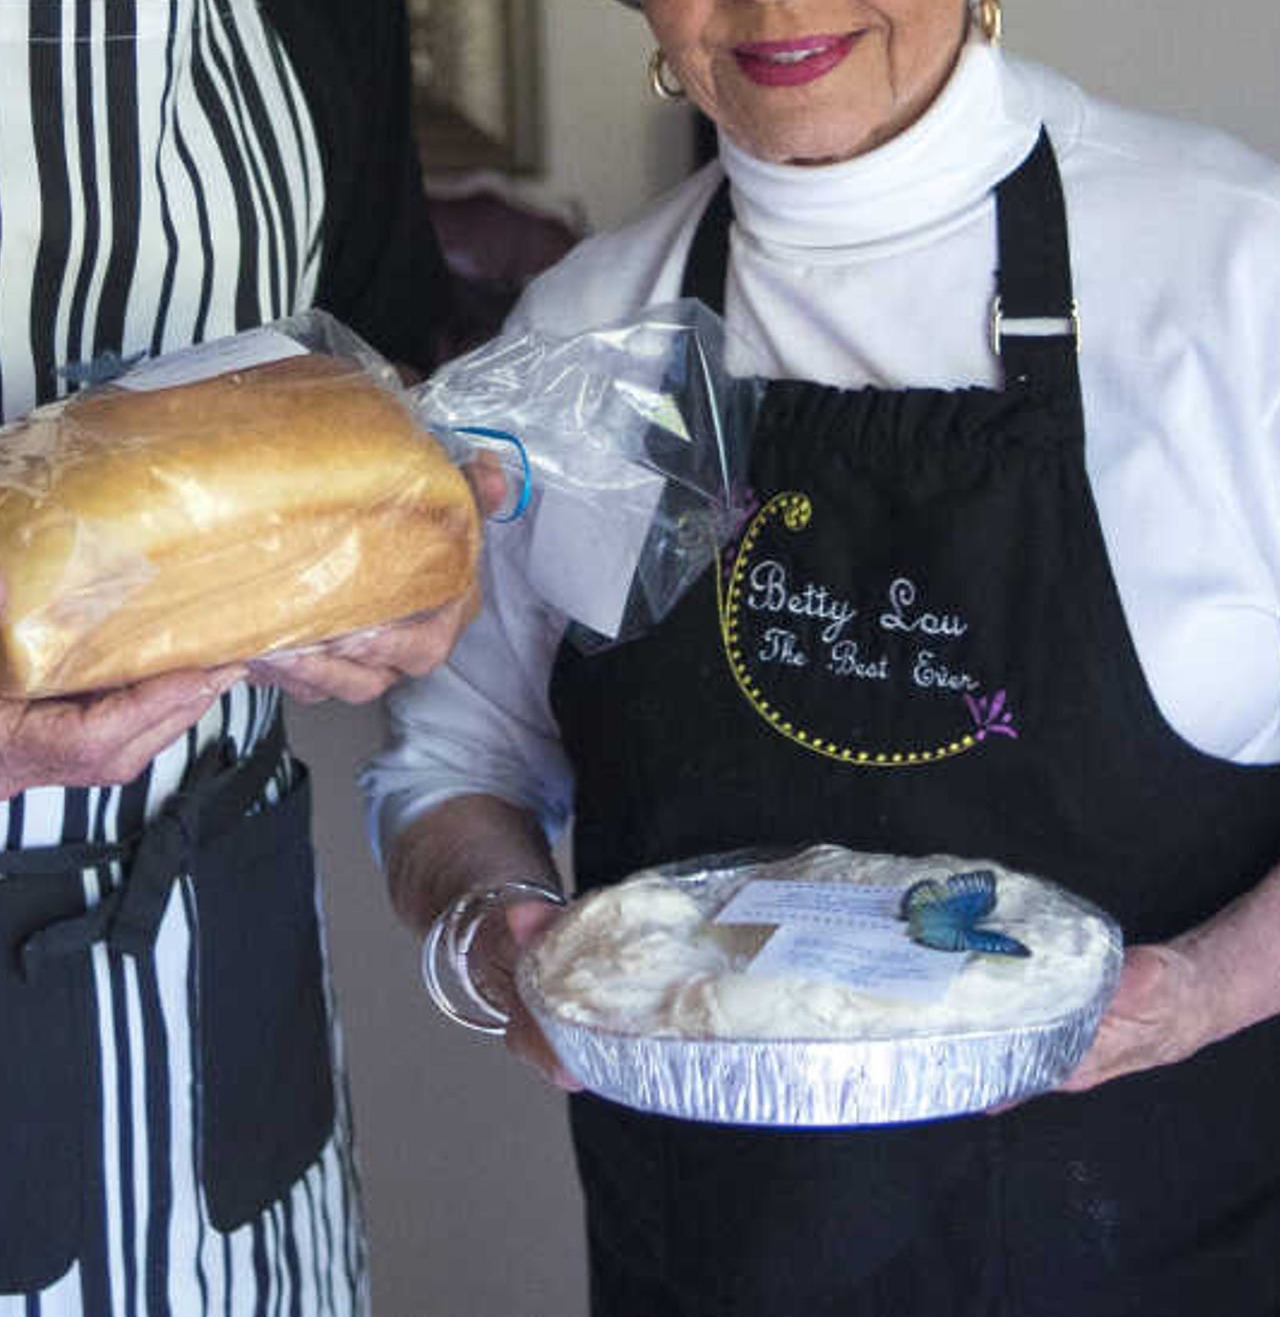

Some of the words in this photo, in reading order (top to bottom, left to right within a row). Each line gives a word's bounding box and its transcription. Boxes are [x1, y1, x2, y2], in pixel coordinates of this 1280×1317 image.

[748, 561, 856, 643] Betty
[880, 578, 968, 636] Lou
[760, 628, 805, 666] The
[827, 640, 888, 679] Best
[914, 650, 981, 690] Ever
